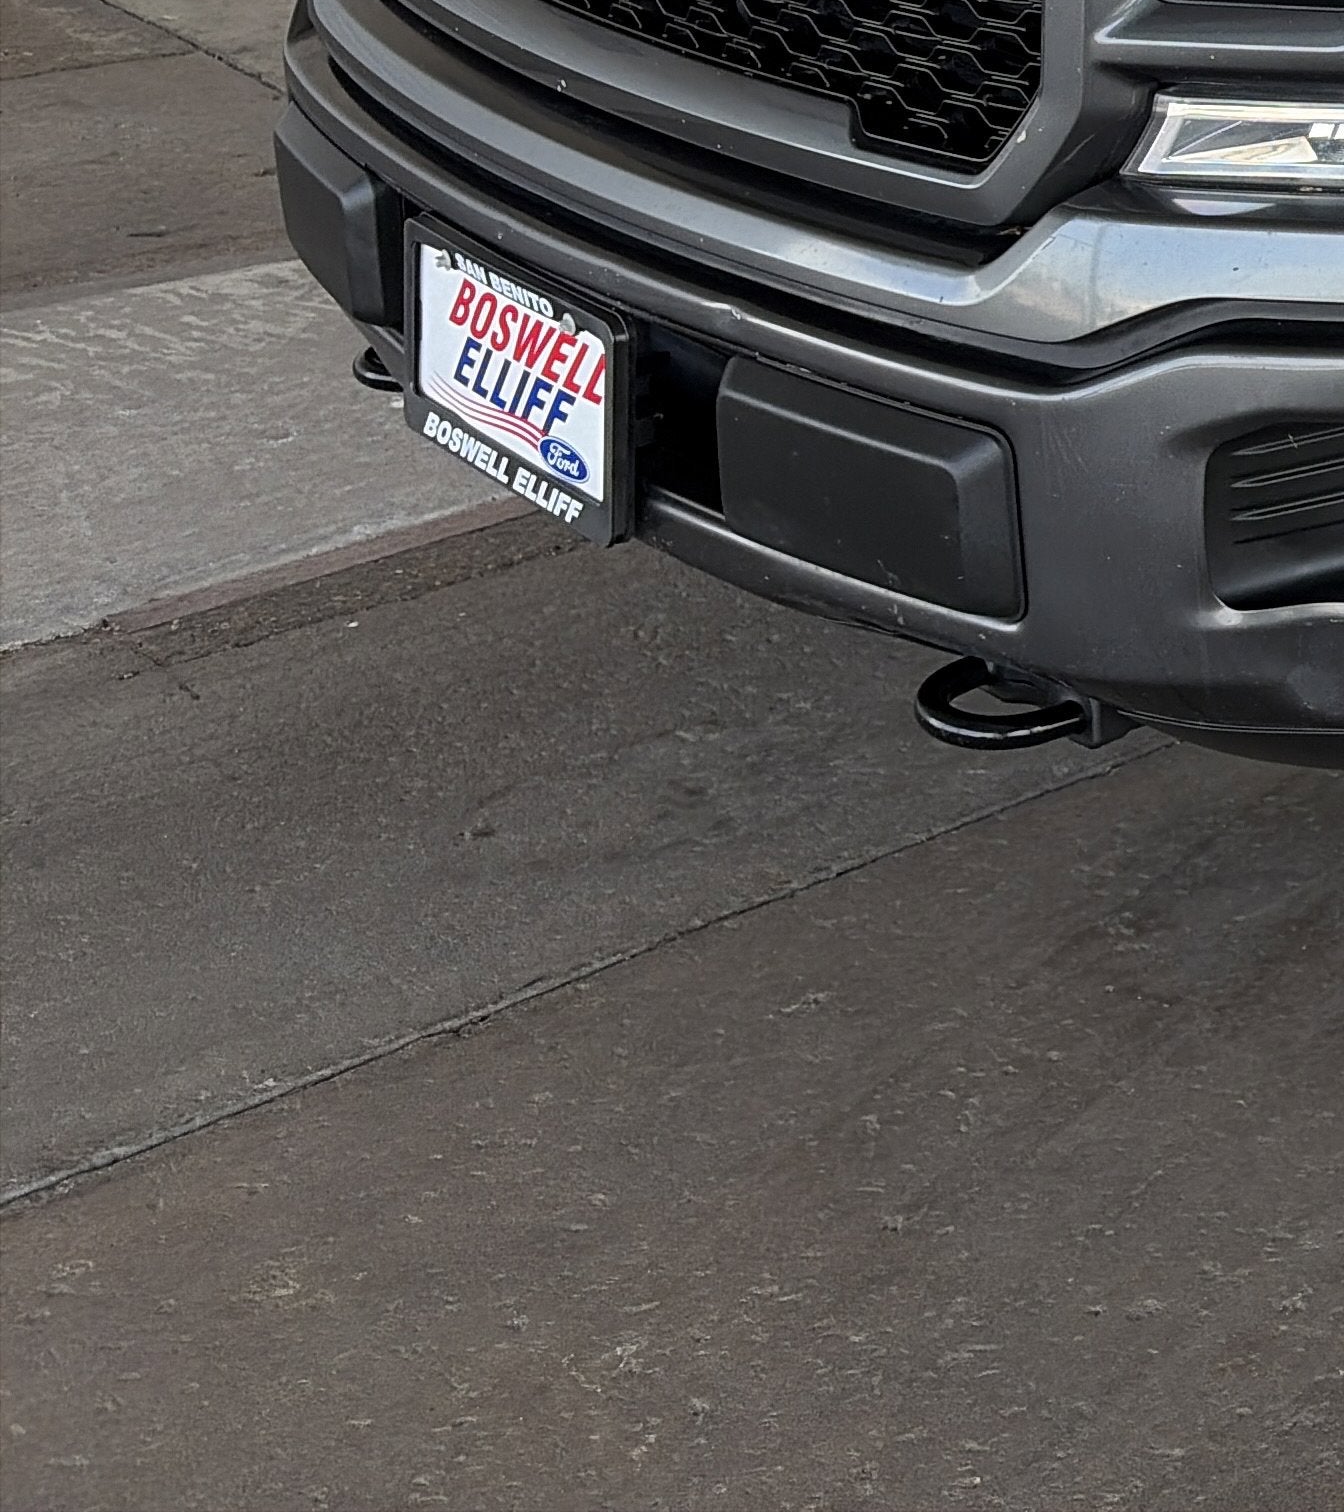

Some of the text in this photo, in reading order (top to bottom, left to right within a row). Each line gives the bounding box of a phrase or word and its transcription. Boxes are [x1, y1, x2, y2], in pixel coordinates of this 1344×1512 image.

[453, 251, 555, 320] SAN BENITO
[449, 277, 606, 406] BOSWELL
[453, 335, 577, 435] ELLIFF
[422, 411, 584, 524] BOSWELL ELLIFF
[547, 442, 581, 477] Ford
